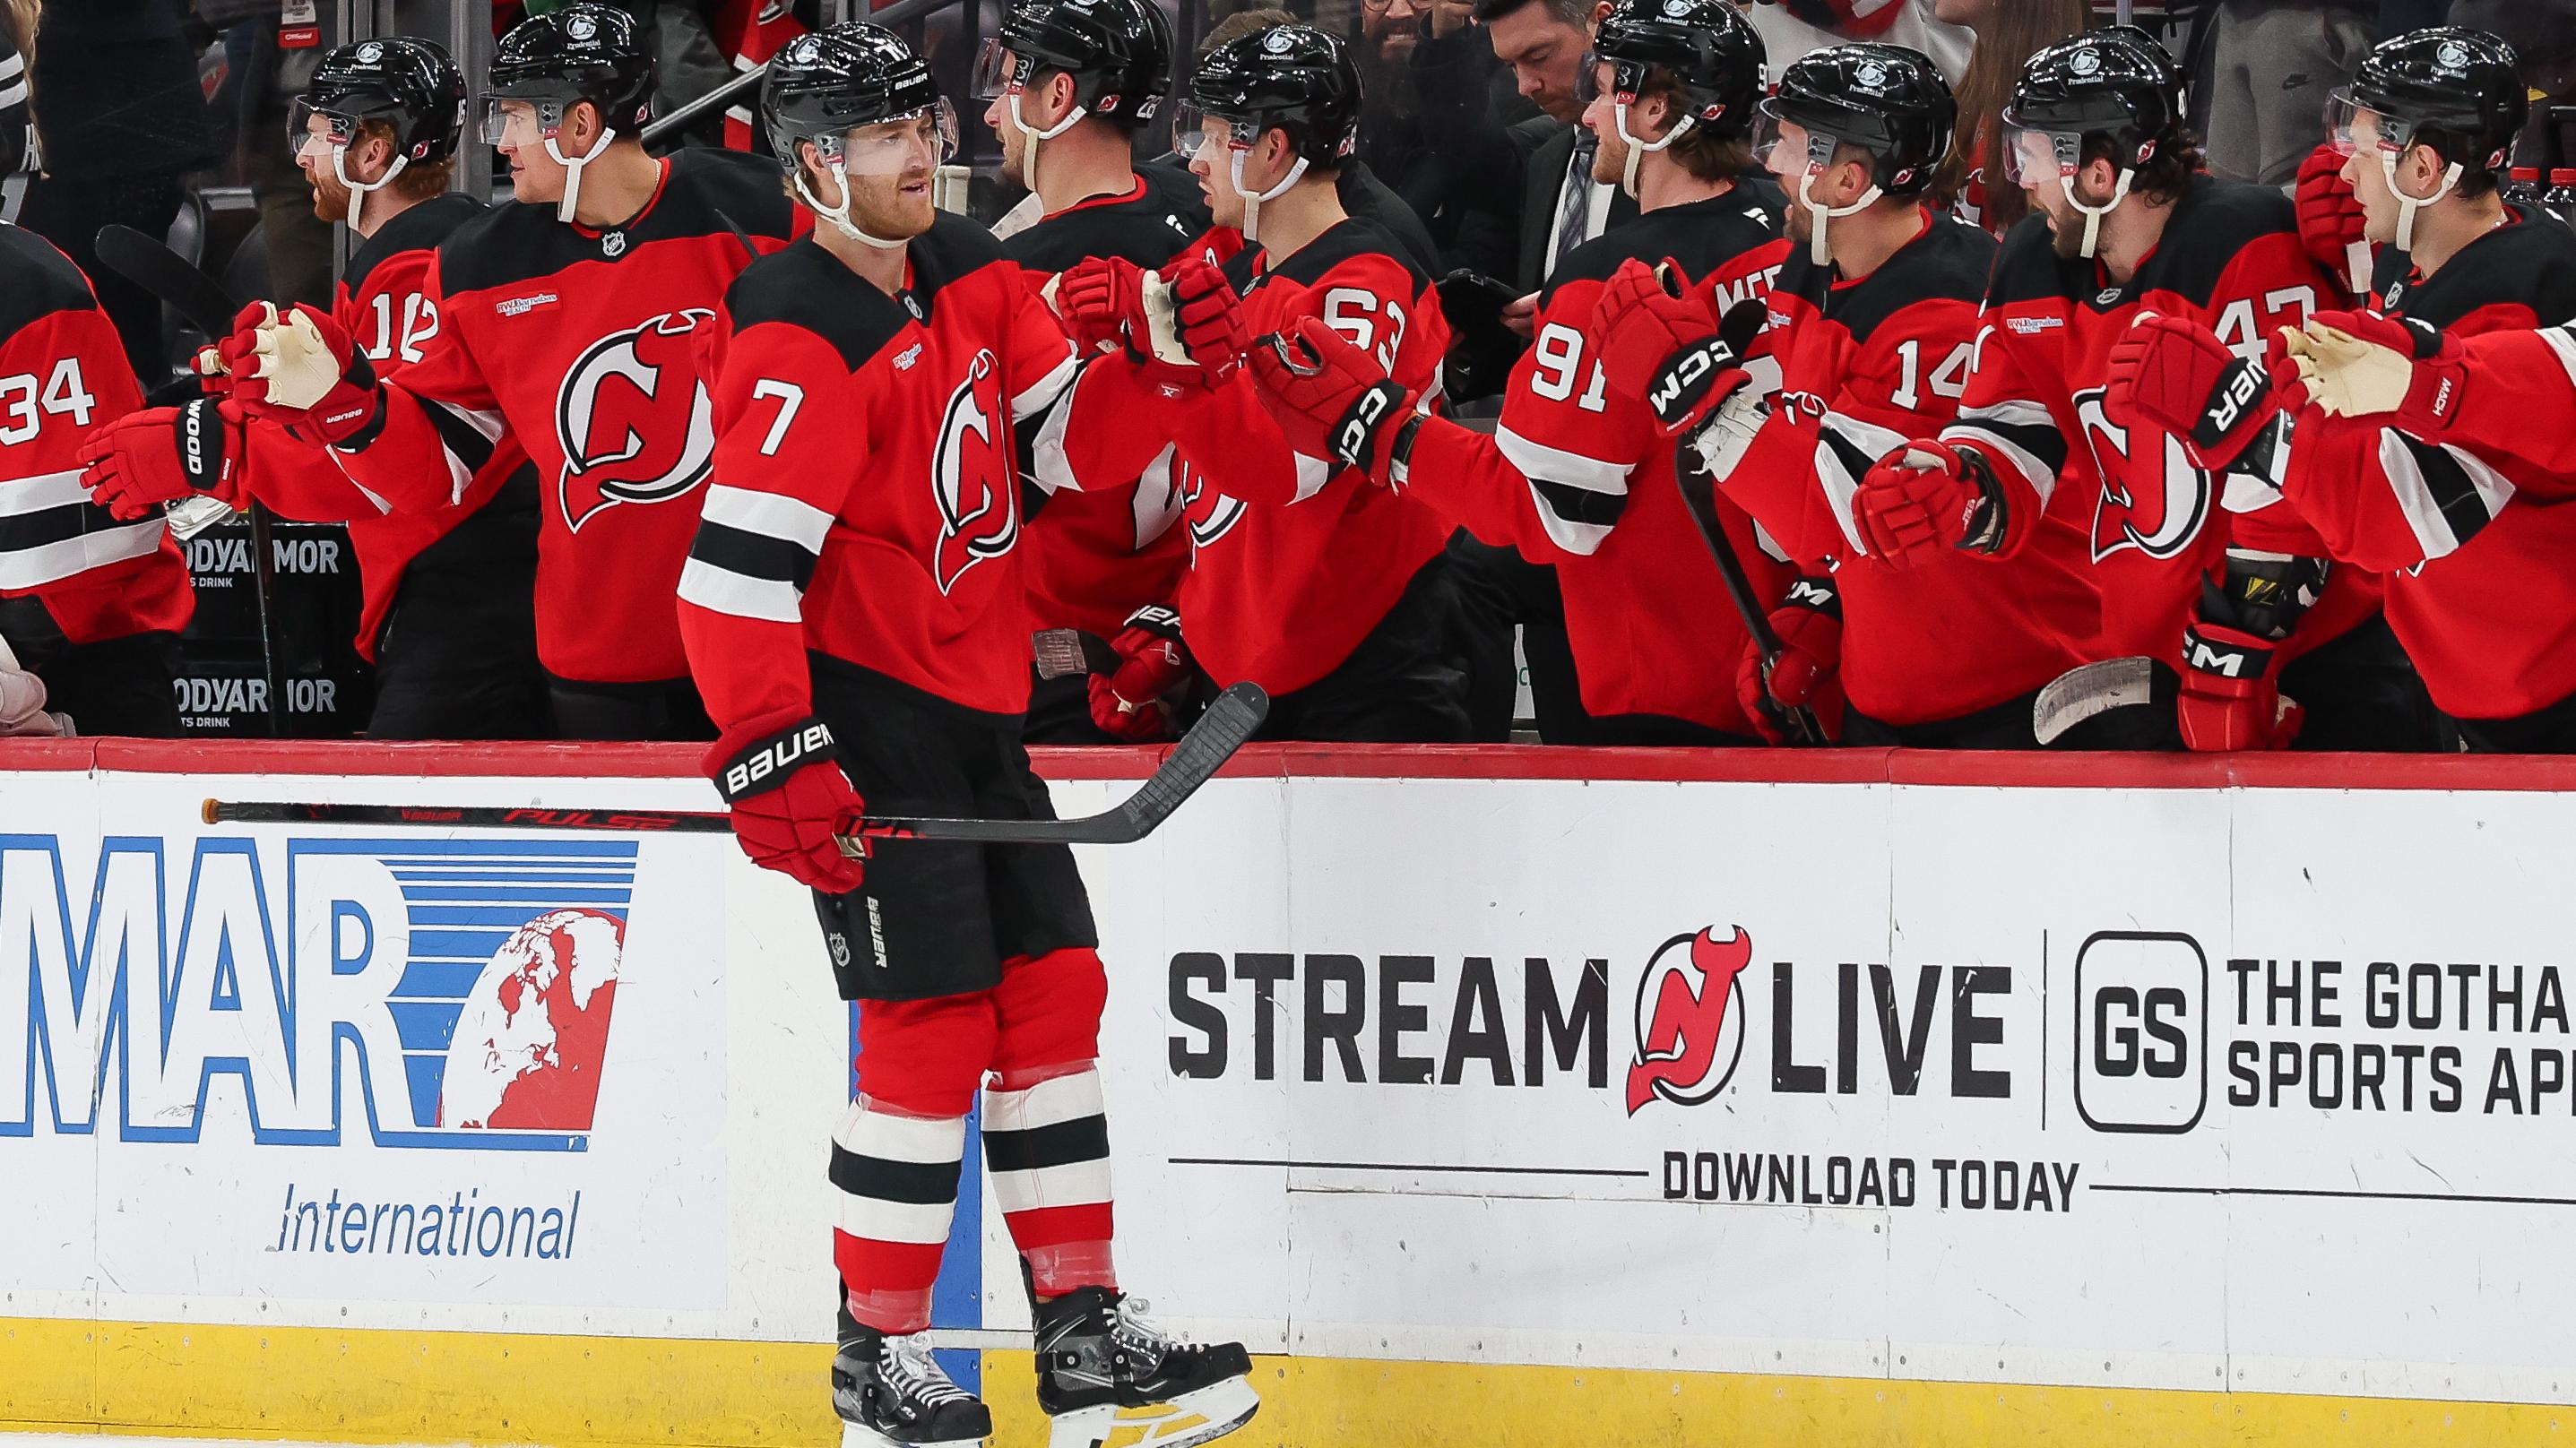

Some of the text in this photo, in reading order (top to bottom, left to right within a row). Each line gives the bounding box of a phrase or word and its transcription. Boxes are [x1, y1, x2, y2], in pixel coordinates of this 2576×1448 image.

[2067, 75, 2104, 85] Prudential
[0, 357, 96, 446] 34
[1649, 340, 1734, 415] CCM
[1891, 340, 1975, 410] 14
[753, 378, 805, 456] 7
[198, 577, 233, 588] DRINK
[195, 718, 230, 728] DRINK
[726, 723, 834, 795] BAUER
[866, 896, 887, 969] BAUER
[1168, 951, 2012, 1099] STREAM LIVE
[2094, 987, 2187, 1078] GS
[2227, 959, 2570, 1034] THE GOTHA
[2227, 1040, 2576, 1116] SPORTS AP
[1664, 1151, 2079, 1213] DOWNLOAD TODAY
[278, 1183, 581, 1260] International
